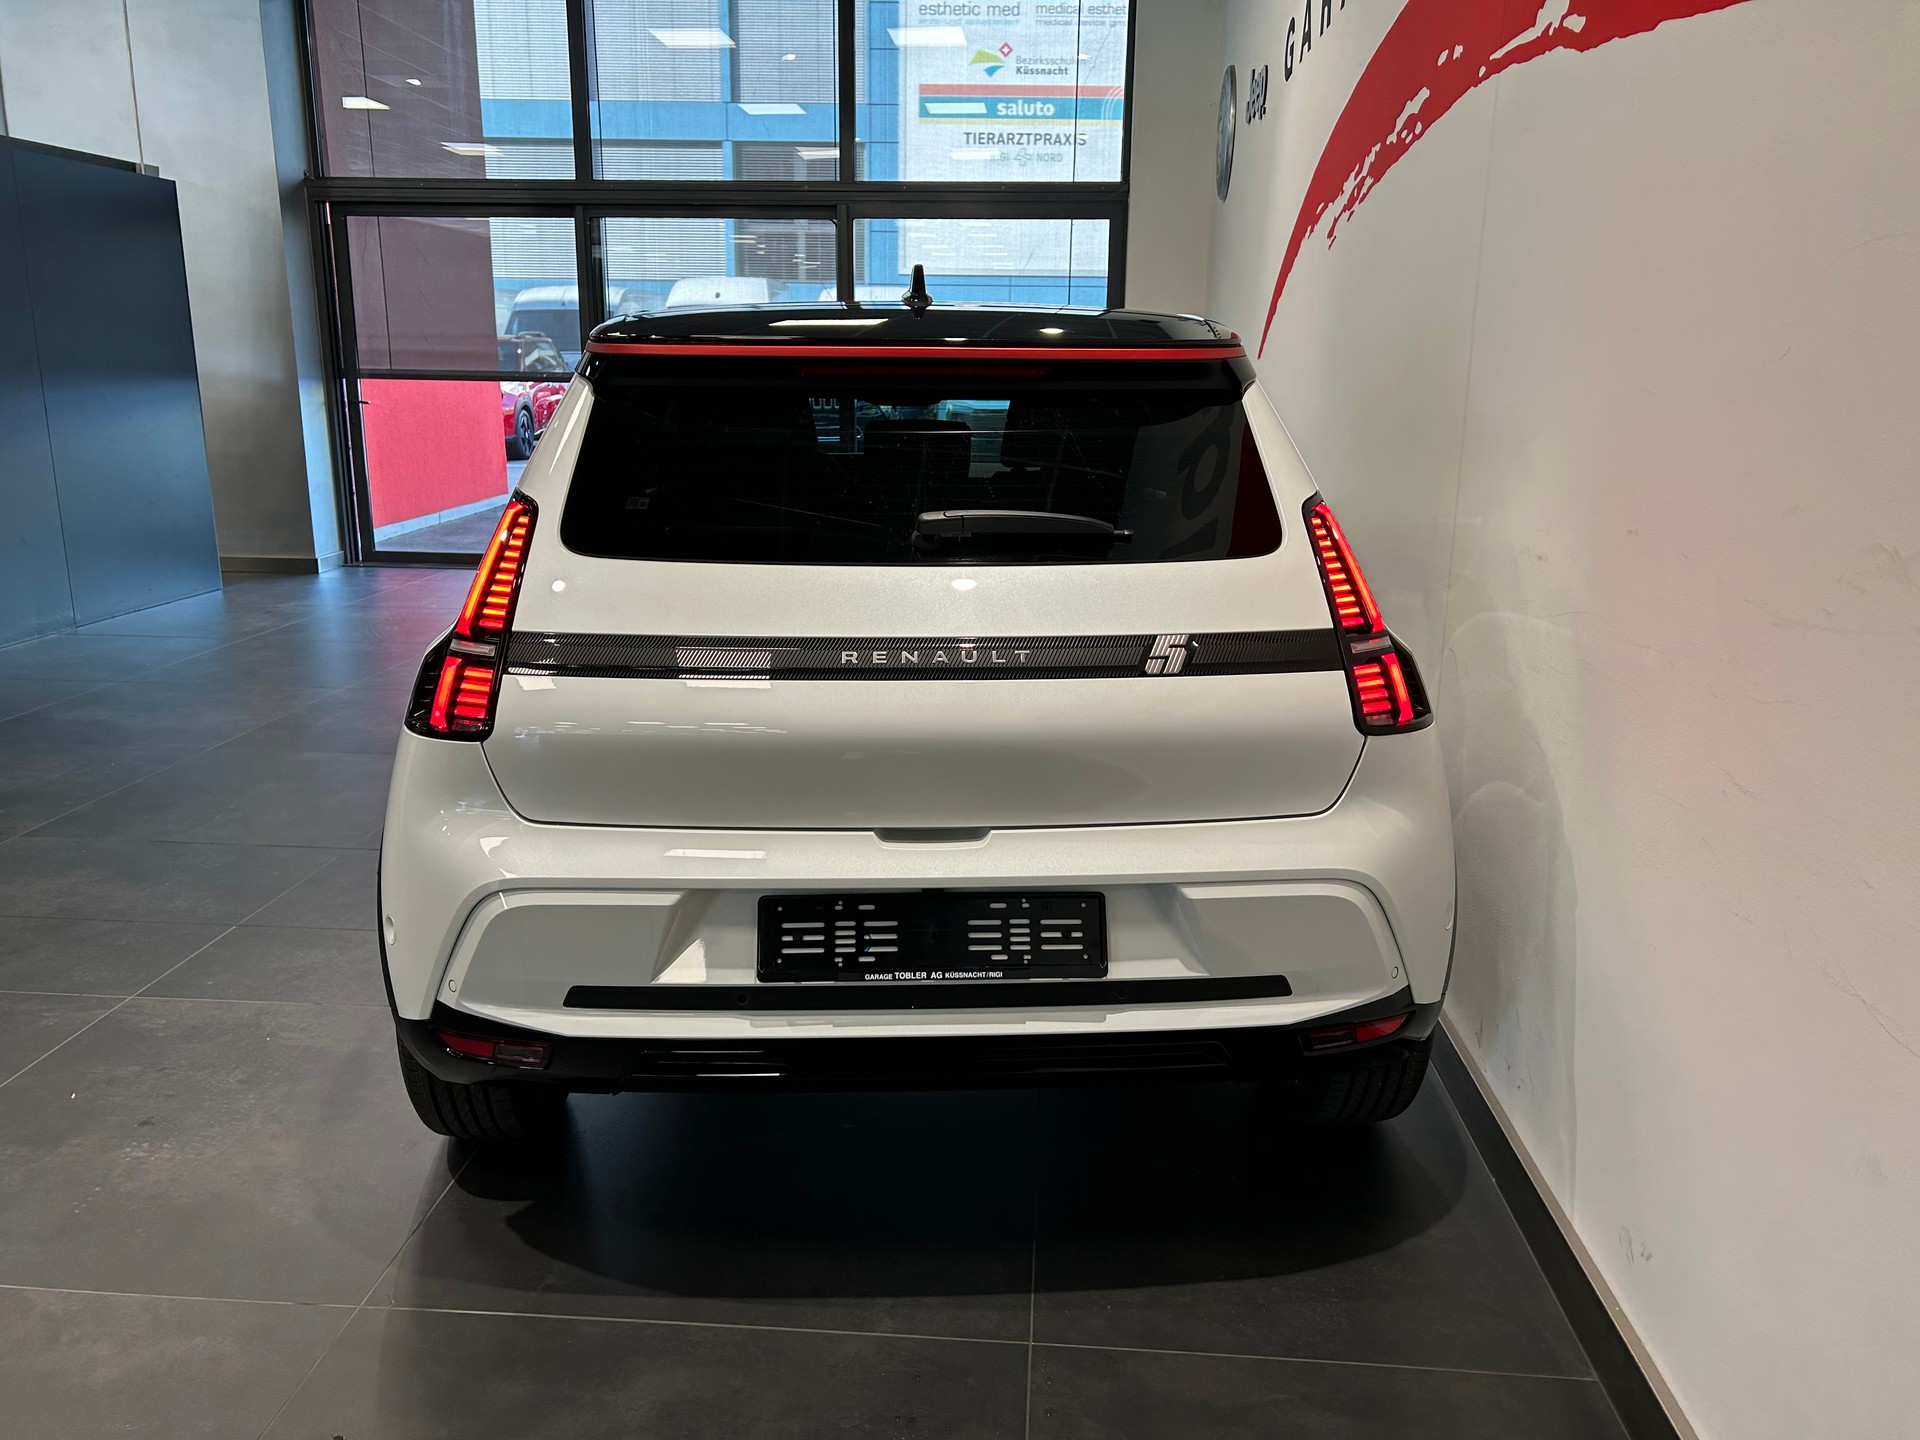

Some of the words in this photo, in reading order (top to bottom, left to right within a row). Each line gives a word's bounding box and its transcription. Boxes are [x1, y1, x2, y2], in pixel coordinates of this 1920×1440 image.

[918, 1, 980, 16] esthetic
[986, 1, 1020, 16] med
[1035, 2, 1083, 14] medical
[1015, 55, 1086, 65] Bezirksschuln
[1015, 65, 1068, 75] Küssnacht
[996, 100, 1055, 116] saluto
[963, 132, 1087, 146] TIERARZTPRAXS
[1036, 152, 1063, 162] NORD
[841, 649, 1033, 664] RENAULT
[1144, 634, 1190, 675] 5
[894, 971, 927, 979] TOBLER
[930, 971, 943, 979] AG
